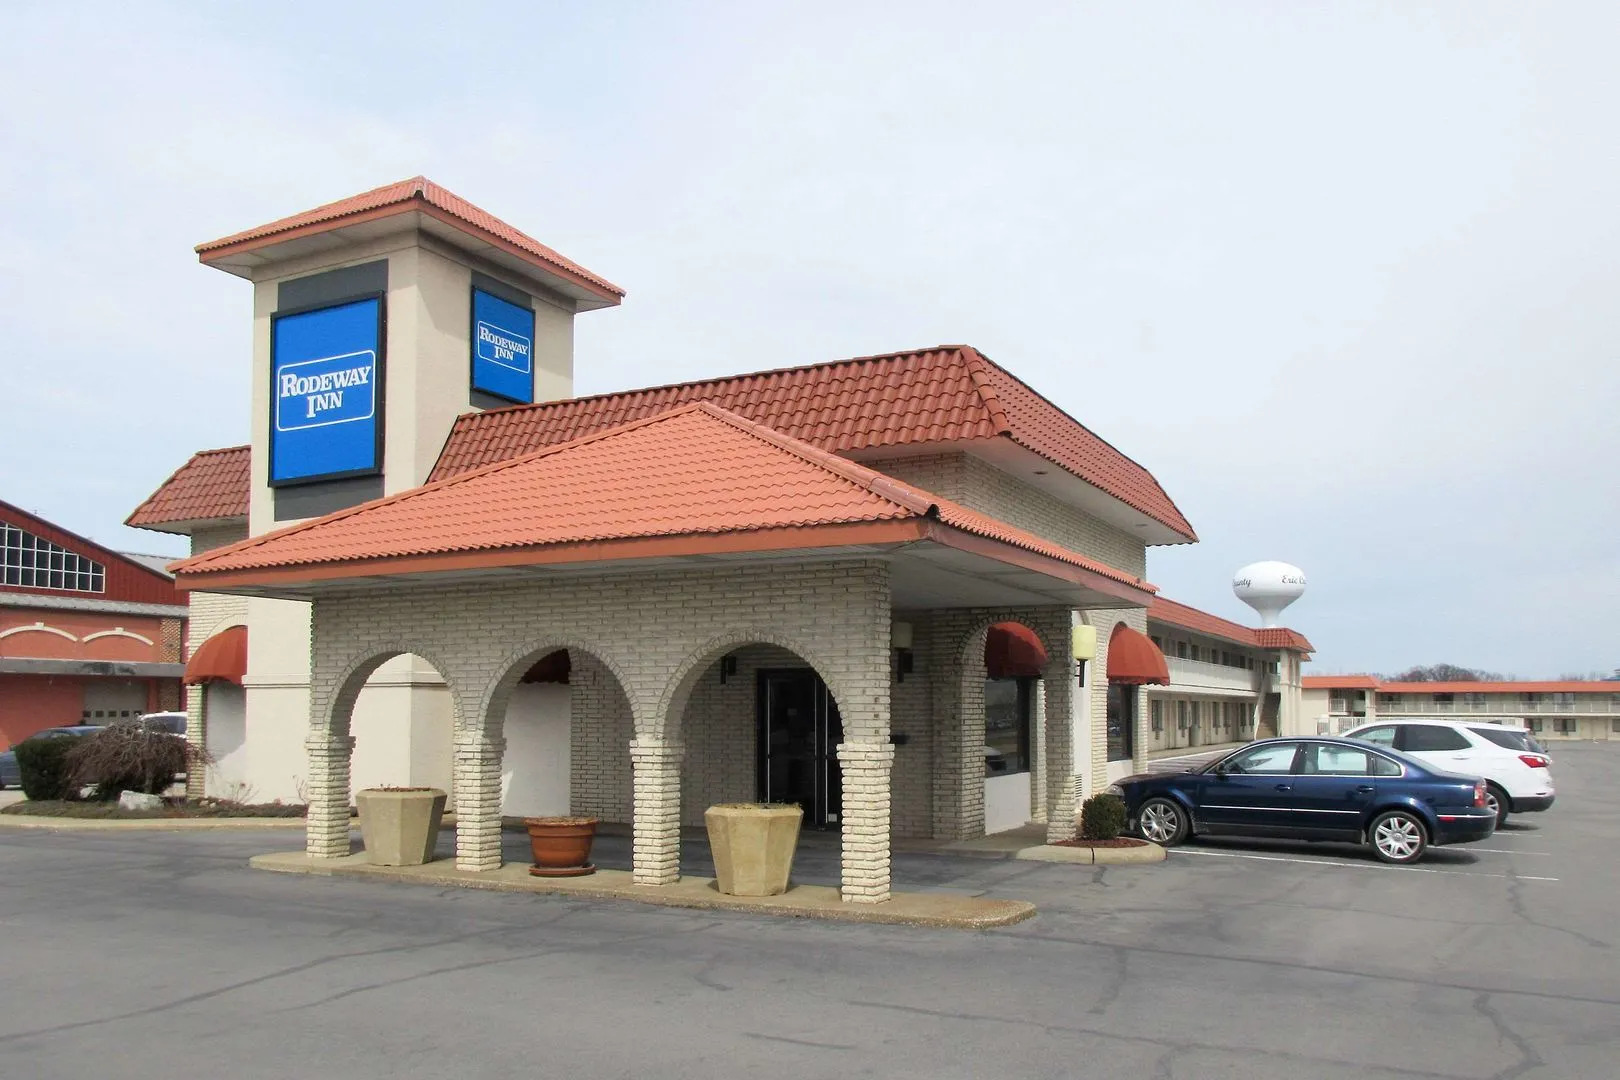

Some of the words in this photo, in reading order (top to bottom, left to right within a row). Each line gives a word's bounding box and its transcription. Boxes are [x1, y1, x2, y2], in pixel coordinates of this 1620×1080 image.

[480, 326, 528, 355] RODEWAY
[494, 346, 514, 361] INN
[281, 366, 371, 398] RODEWAY
[306, 391, 343, 418] INN
